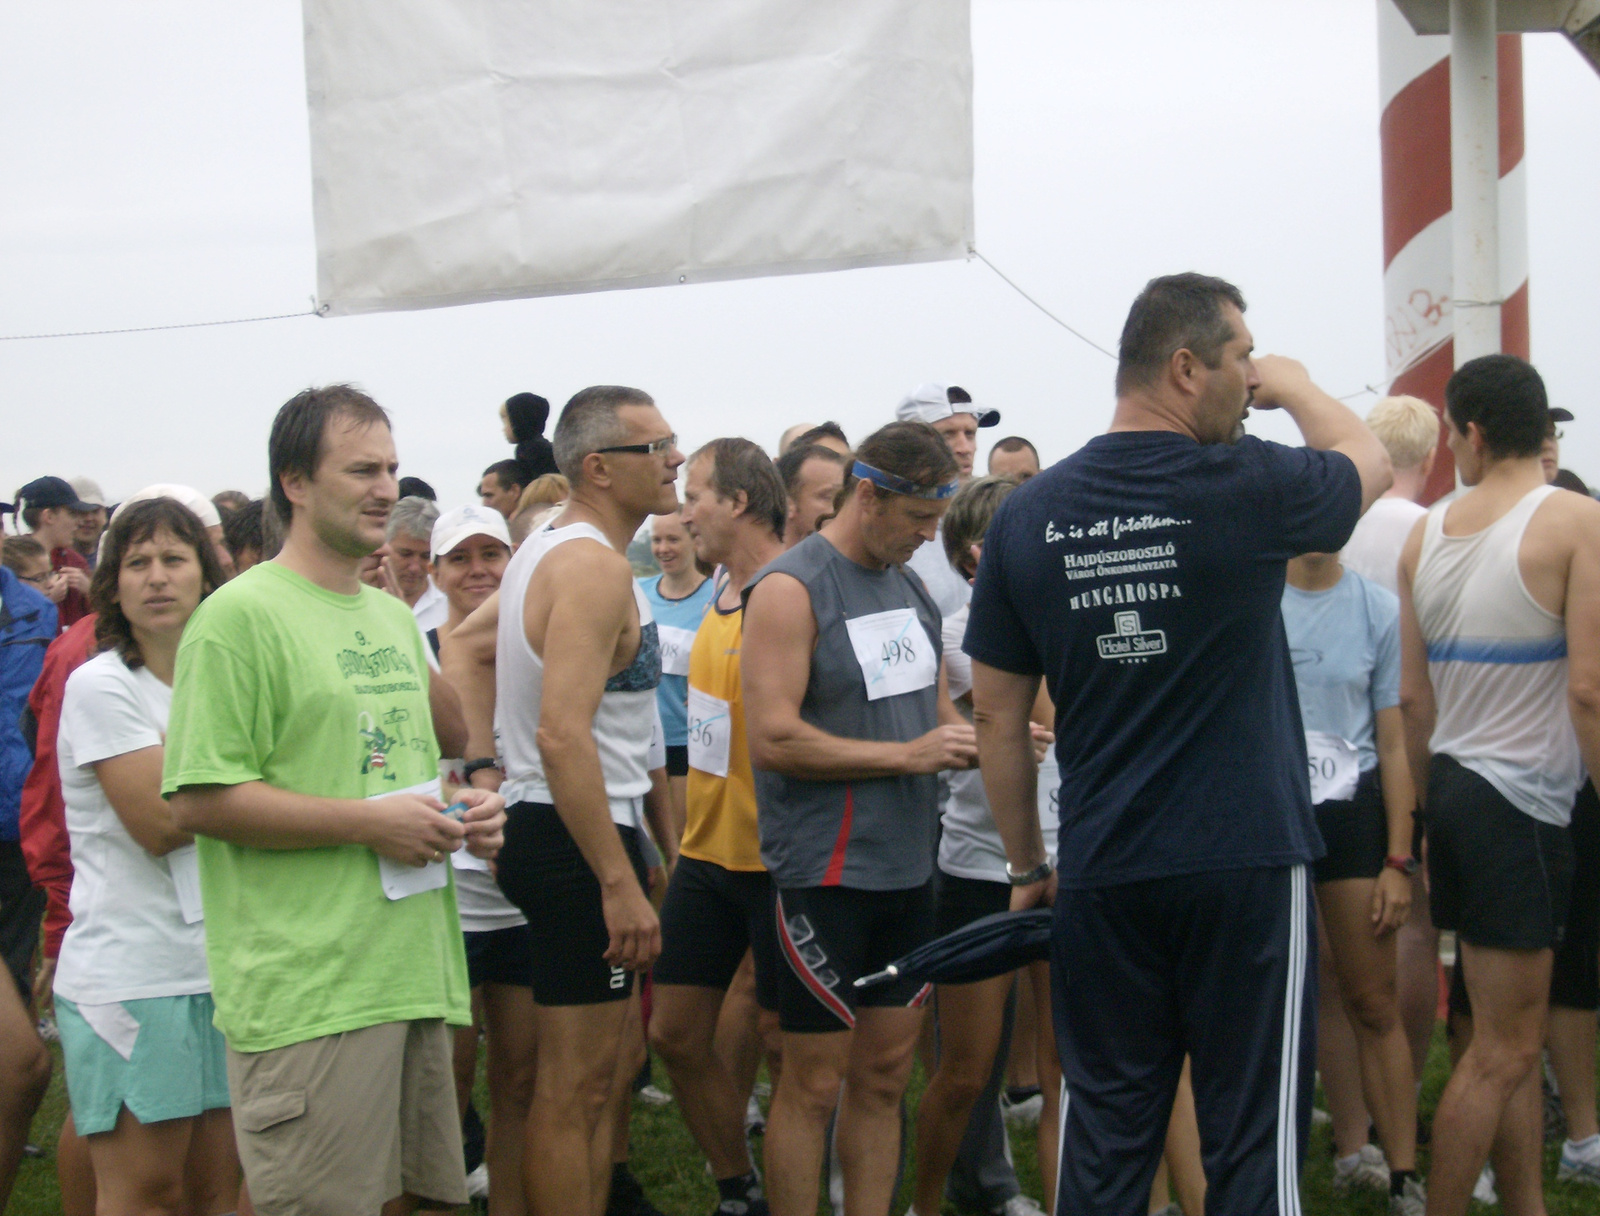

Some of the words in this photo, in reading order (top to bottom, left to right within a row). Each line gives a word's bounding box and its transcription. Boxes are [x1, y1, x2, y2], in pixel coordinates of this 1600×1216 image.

[1069, 525, 1084, 539] is
[1087, 519, 1110, 537] ott
[1069, 582, 1182, 610] HUNGAROSPA
[881, 636, 916, 667] 498
[1101, 638, 1132, 655] Hotel
[1132, 636, 1162, 652] Silver
